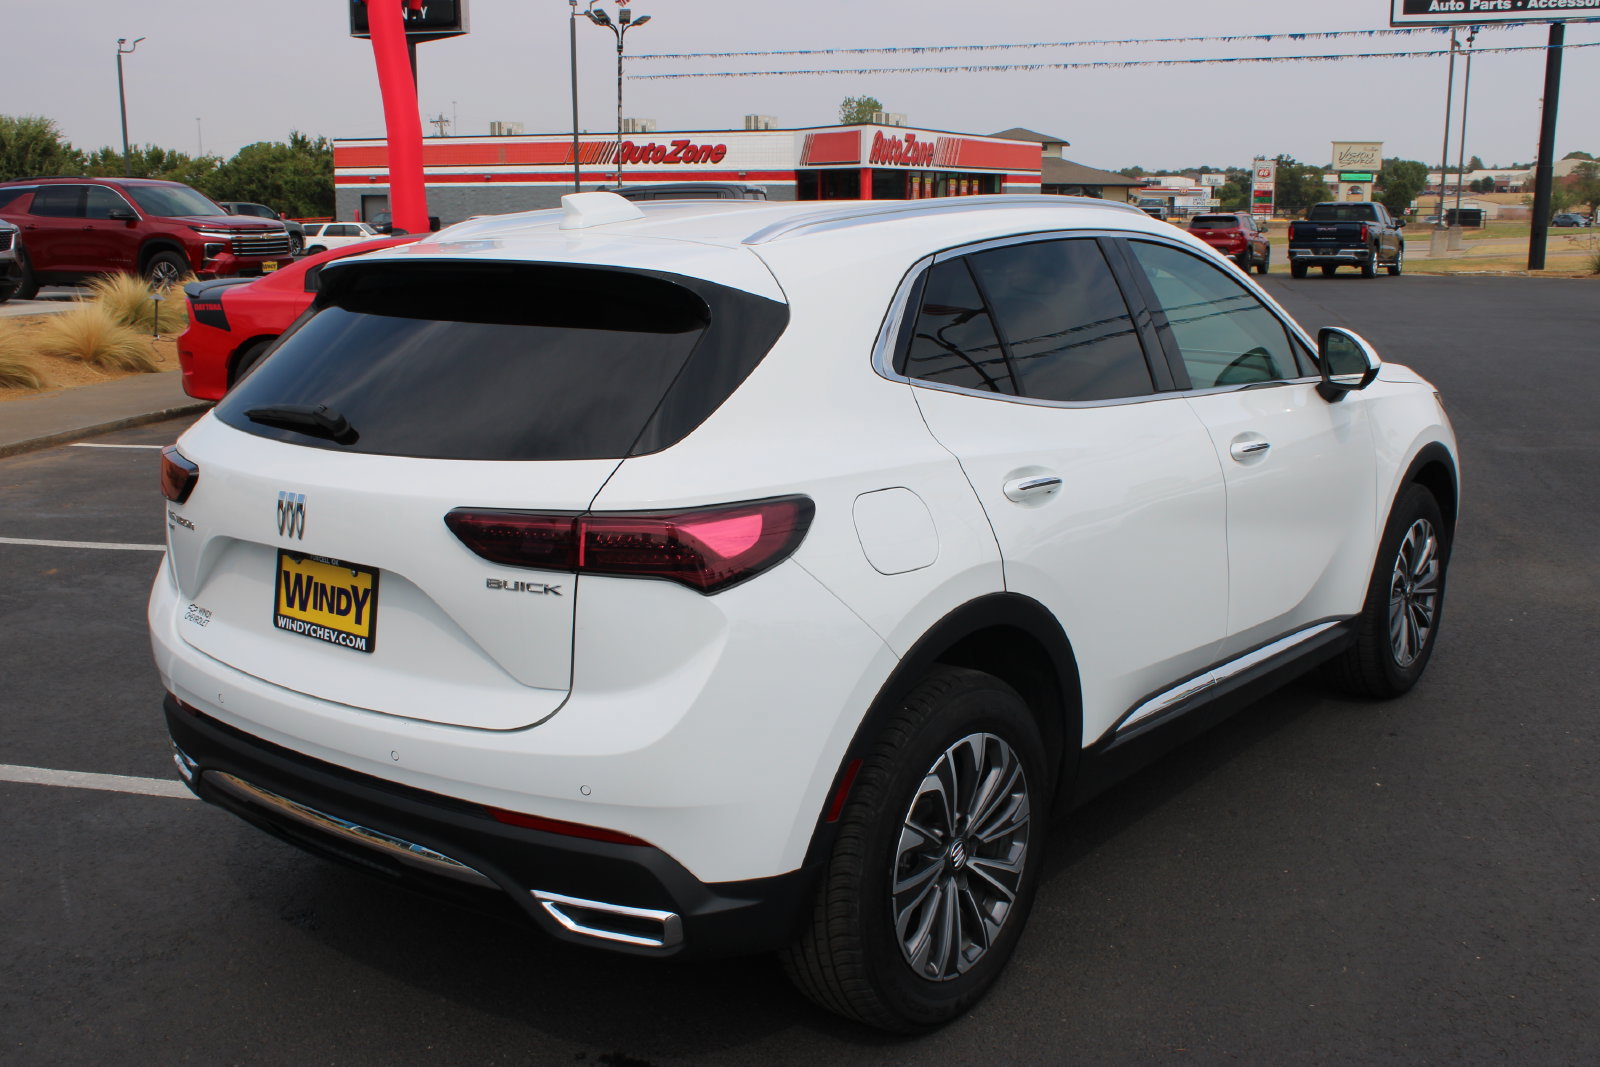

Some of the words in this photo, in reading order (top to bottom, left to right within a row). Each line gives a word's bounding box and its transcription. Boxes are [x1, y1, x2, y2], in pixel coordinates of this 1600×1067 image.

[1428, 0, 1465, 11] Auto
[1469, 0, 1512, 10] Parts
[612, 140, 727, 164] AutoZone
[868, 130, 935, 167] AutoZone
[194, 303, 222, 311] DAYTONA
[283, 569, 372, 626] WINDY
[486, 578, 562, 596] BUICK
[277, 615, 366, 651] WINDYCHEV.COM
